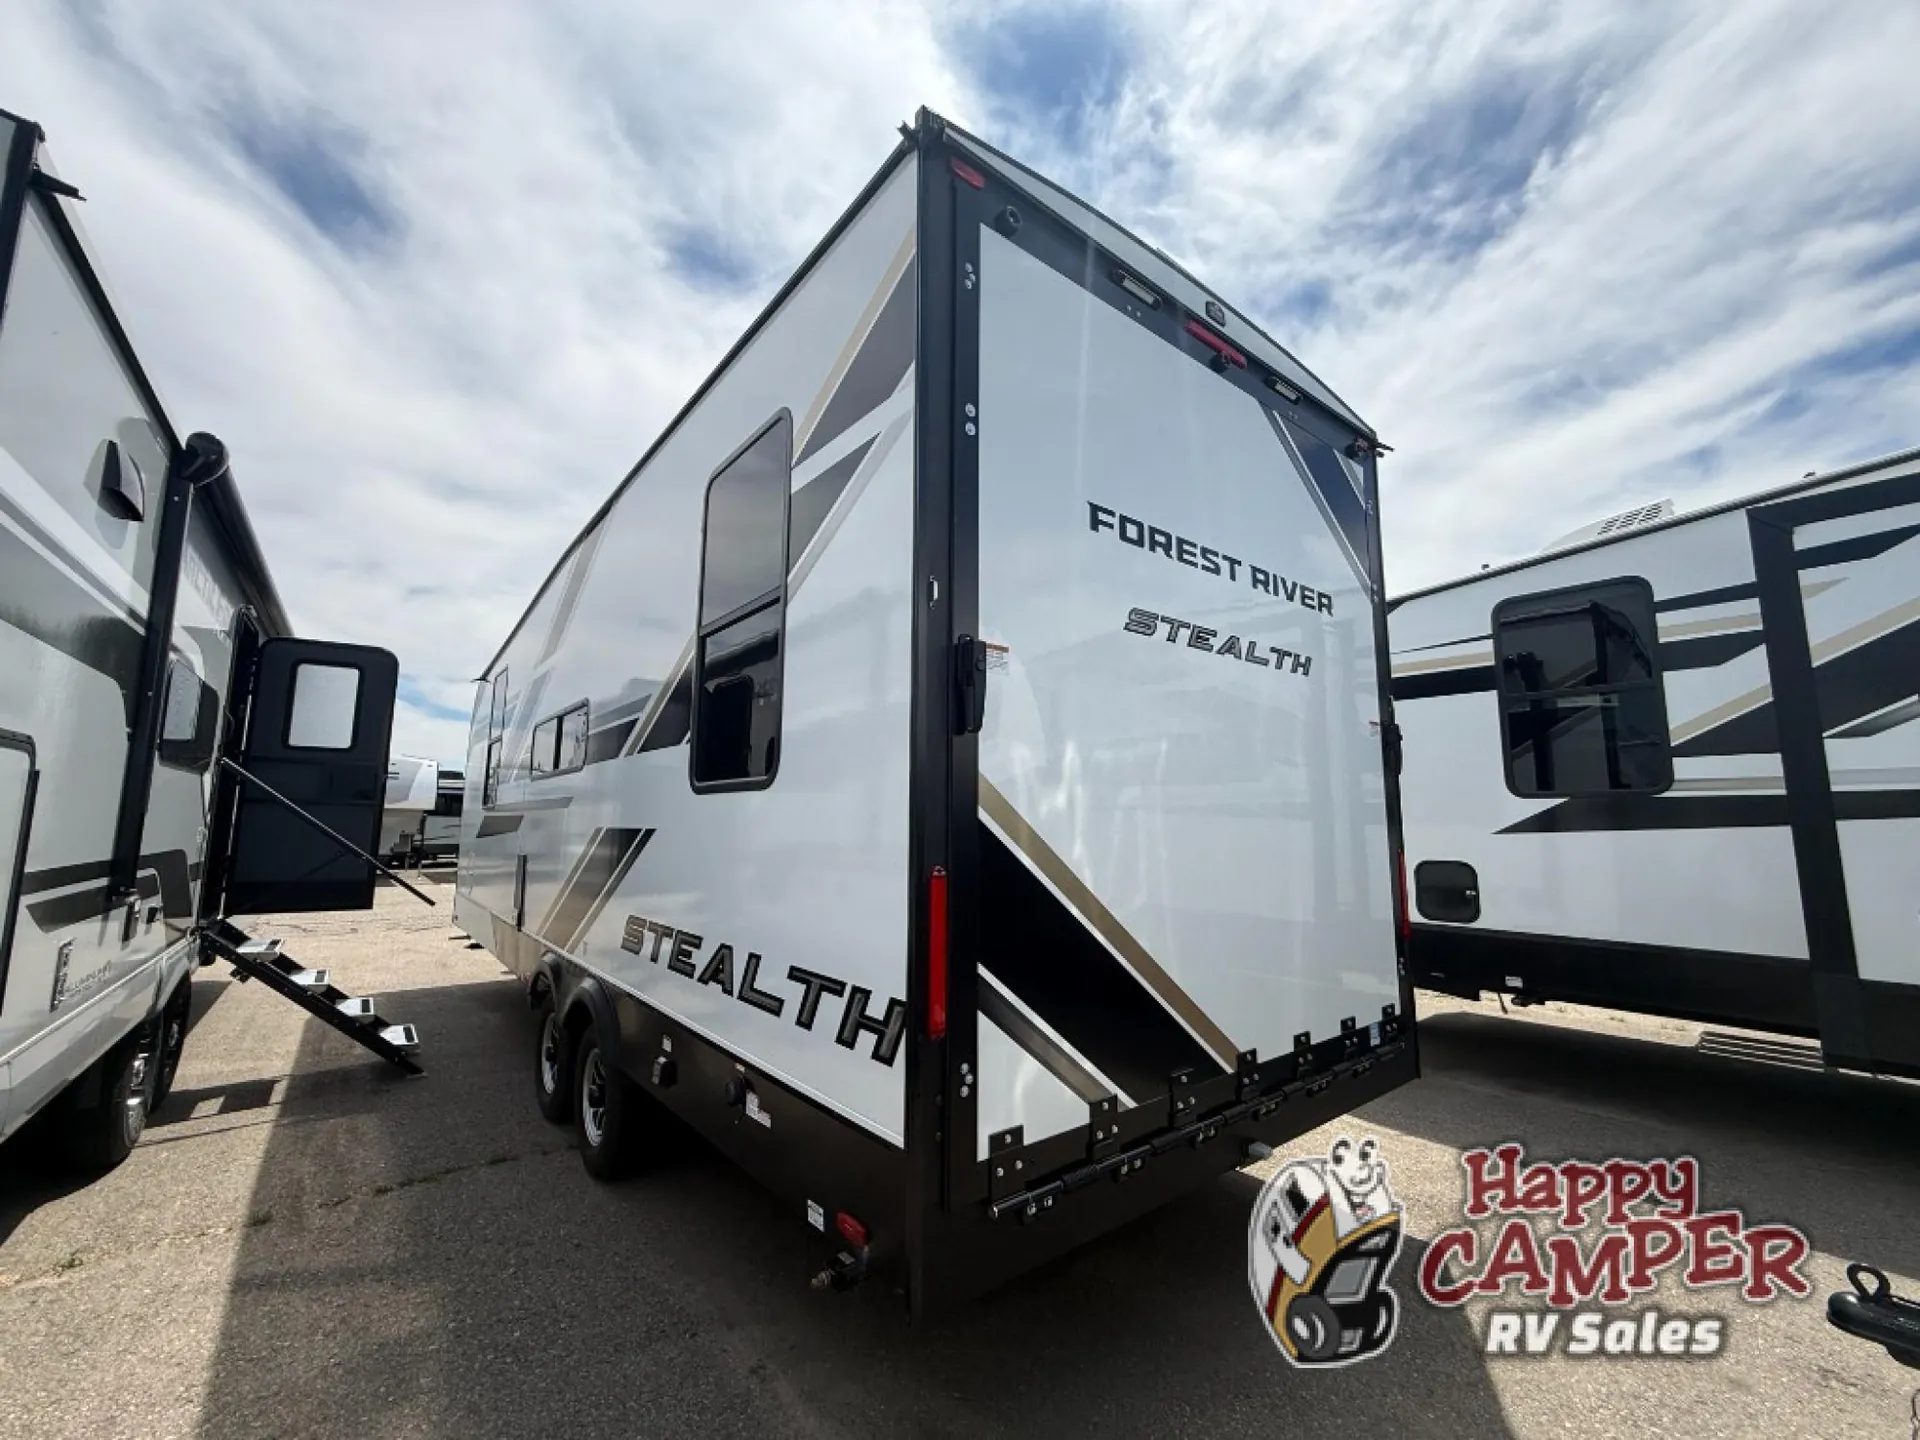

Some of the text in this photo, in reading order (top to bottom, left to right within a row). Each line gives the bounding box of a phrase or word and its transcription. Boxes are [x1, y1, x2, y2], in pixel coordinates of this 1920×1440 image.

[1087, 501, 1334, 617] FOREST RIVER
[1123, 607, 1313, 677] STEALTH
[620, 914, 907, 1067] STEALTH
